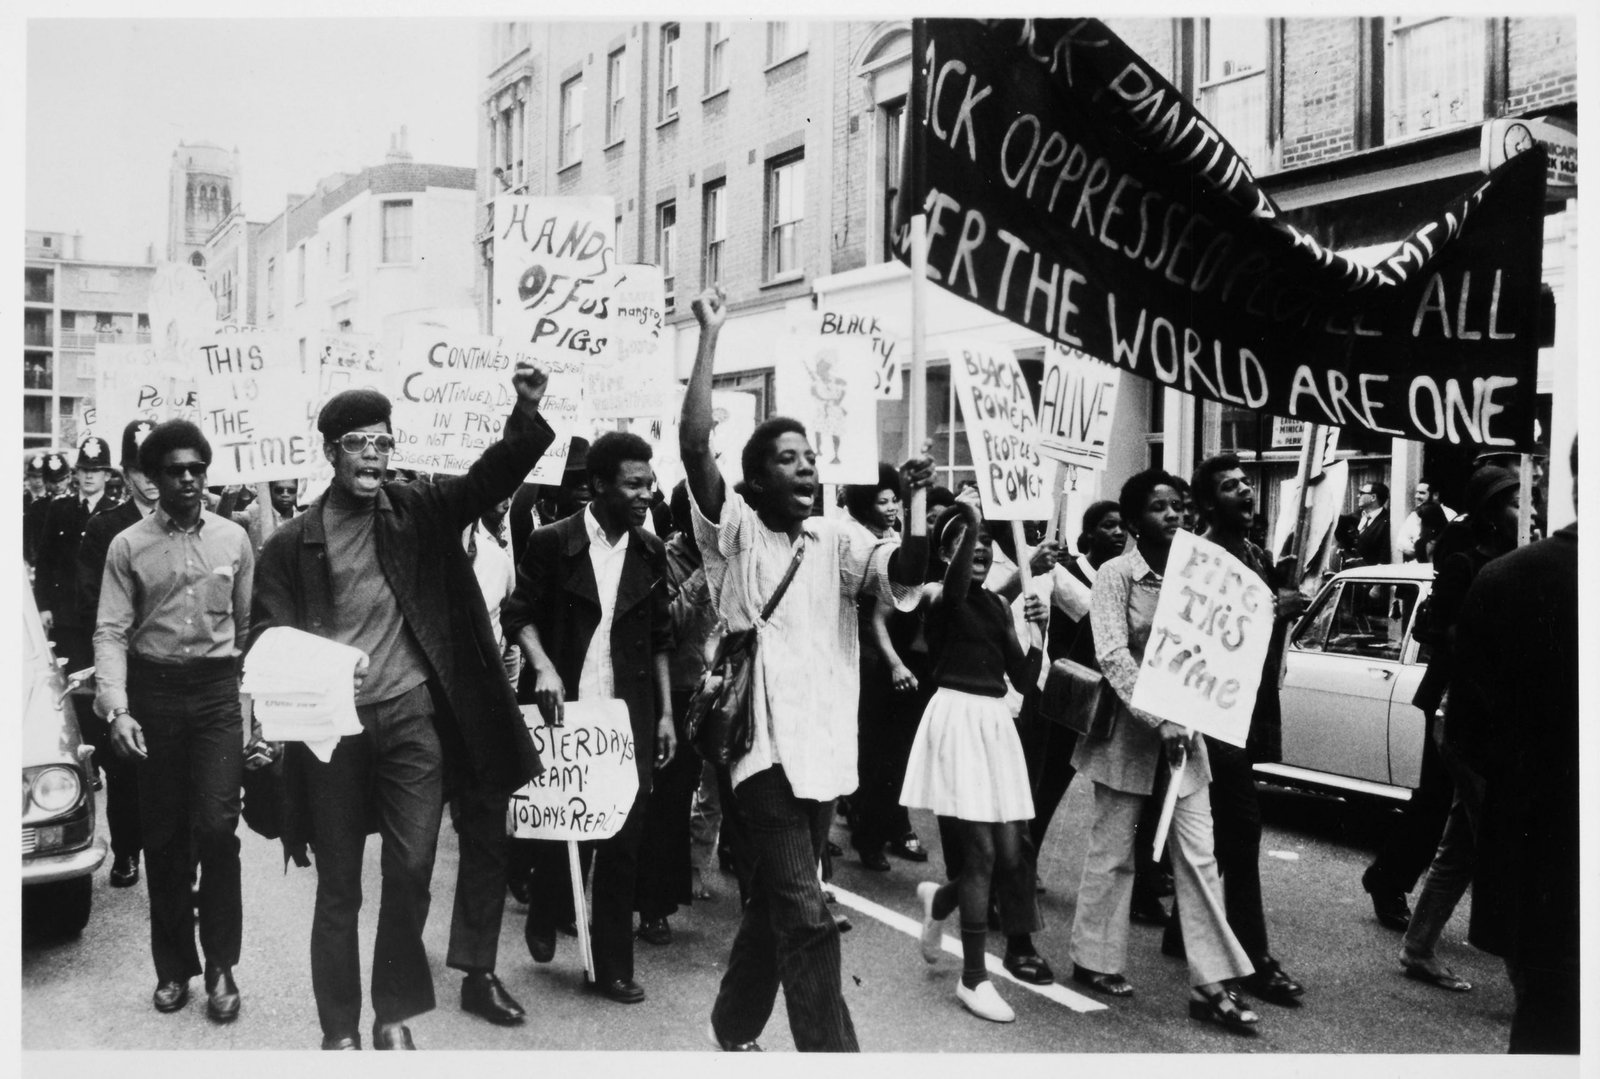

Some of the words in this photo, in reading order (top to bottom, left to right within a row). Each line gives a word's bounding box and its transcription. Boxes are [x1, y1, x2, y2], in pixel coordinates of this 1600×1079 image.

[502, 203, 614, 277] HANDS
[517, 264, 595, 317] OFF
[1412, 269, 1516, 340] ALL
[530, 317, 608, 356] PIGS
[820, 312, 882, 335] BLACK
[997, 228, 1088, 348] THE
[1107, 292, 1269, 408] WORLD
[1288, 364, 1405, 435] ARE
[1408, 375, 1518, 446] ONE
[201, 345, 264, 376] THIS
[428, 341, 511, 371] CONTINUED
[231, 379, 259, 401] IS
[402, 371, 493, 406] CONTINUED
[963, 350, 1026, 403] BLACK
[209, 409, 255, 437] THE
[433, 412, 453, 429] IN
[1041, 365, 1114, 446] ALIVE
[221, 434, 306, 473] TIME
[427, 432, 456, 447] NOT
[528, 725, 635, 765] STERDAYS
